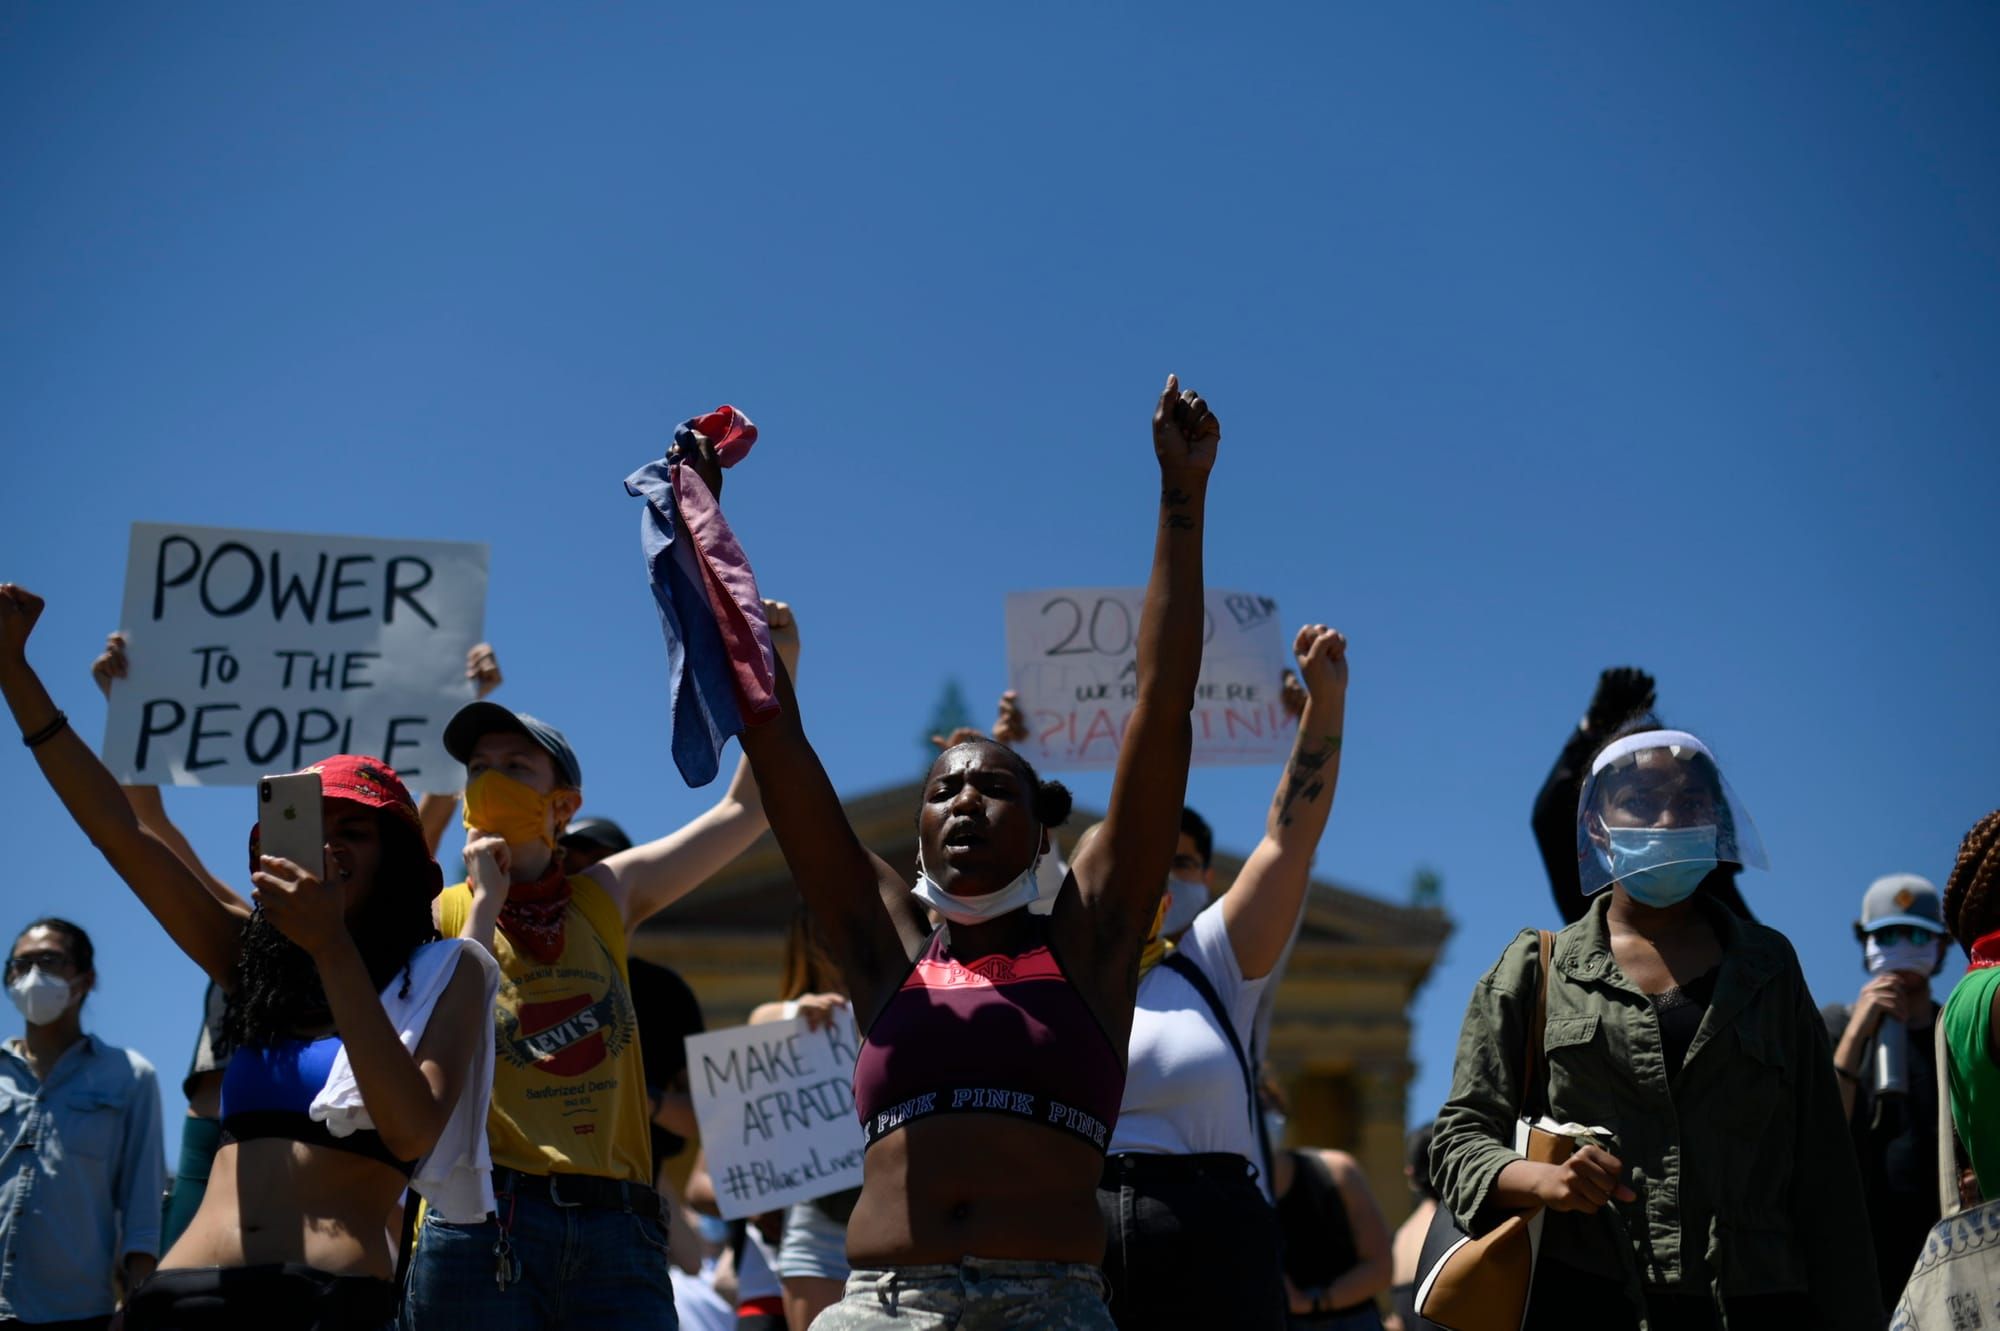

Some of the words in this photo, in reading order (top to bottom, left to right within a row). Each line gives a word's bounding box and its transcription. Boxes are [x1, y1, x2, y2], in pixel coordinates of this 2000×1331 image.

[153, 534, 438, 628] POWER
[191, 646, 240, 690] TO
[273, 650, 382, 692] THE
[947, 958, 1017, 986] PINK
[526, 1010, 600, 1059] LEVI'S
[702, 1033, 816, 1098] MAKE
[743, 1077, 857, 1147] AFRAID
[877, 1092, 937, 1134] PINK
[952, 1089, 1035, 1116] PINK
[1049, 1101, 1108, 1149] PINK
